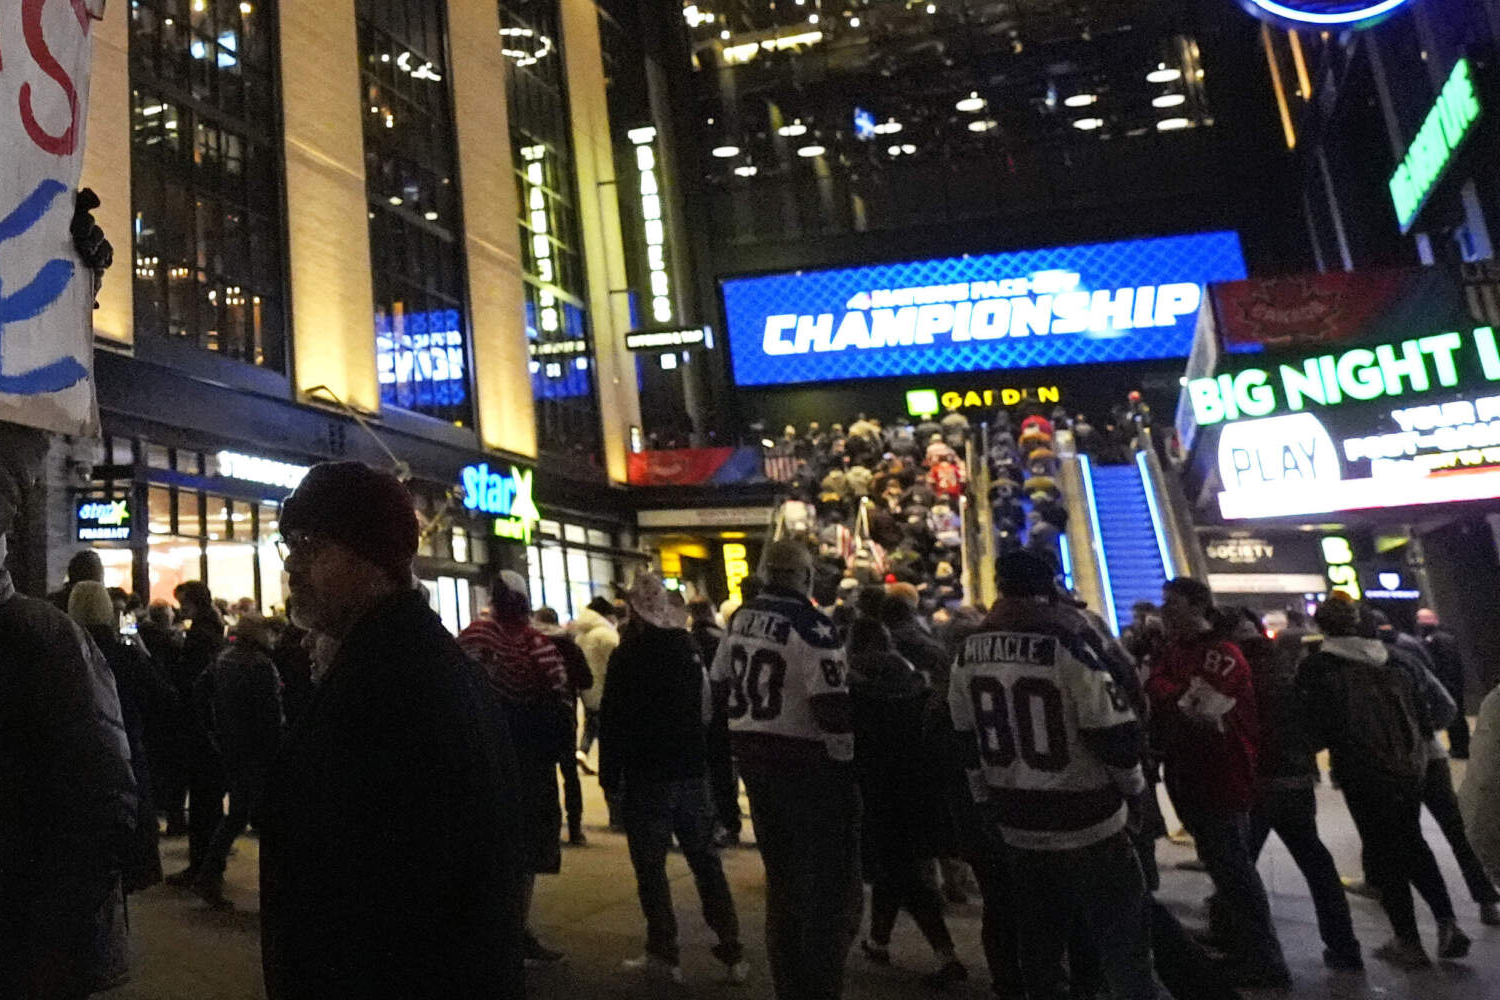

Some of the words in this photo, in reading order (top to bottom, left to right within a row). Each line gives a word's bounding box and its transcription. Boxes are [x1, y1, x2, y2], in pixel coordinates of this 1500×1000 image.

[762, 282, 1200, 356] CHAMPIONSHIP
[941, 386, 1060, 410] GADN
[1187, 368, 1277, 426] BIG
[1279, 331, 1462, 412] NIGHT
[1231, 437, 1318, 487] PLAY
[726, 643, 788, 721] 80
[963, 634, 1041, 664] MIRACLE
[970, 675, 1072, 773] 80
